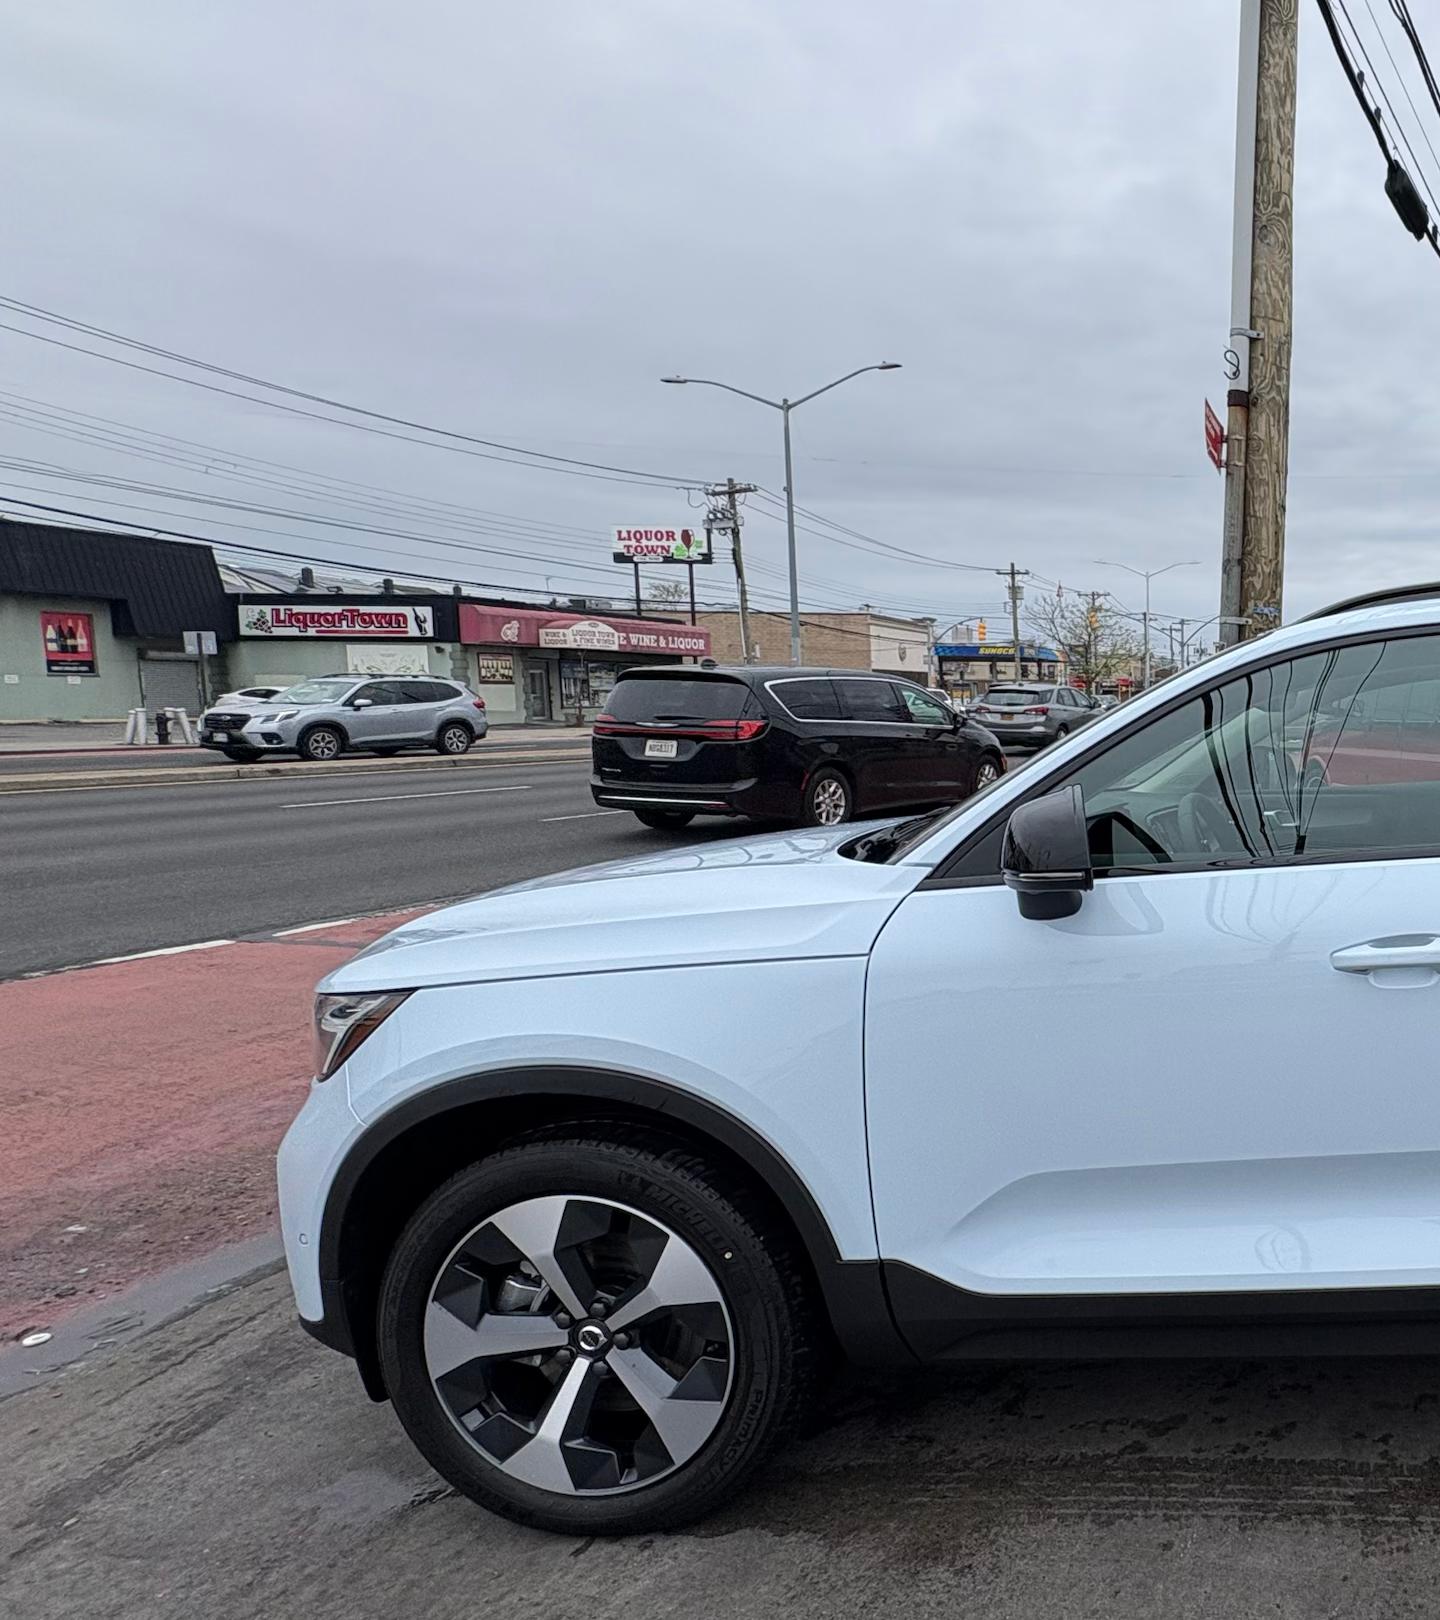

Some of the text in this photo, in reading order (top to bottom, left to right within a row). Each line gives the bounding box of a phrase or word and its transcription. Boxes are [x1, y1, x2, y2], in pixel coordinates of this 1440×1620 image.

[616, 529, 677, 543] LIQUOR
[623, 544, 671, 556] TOWN
[629, 633, 658, 647] WINE
[659, 635, 667, 648] &
[668, 636, 705, 650] LIQUOR
